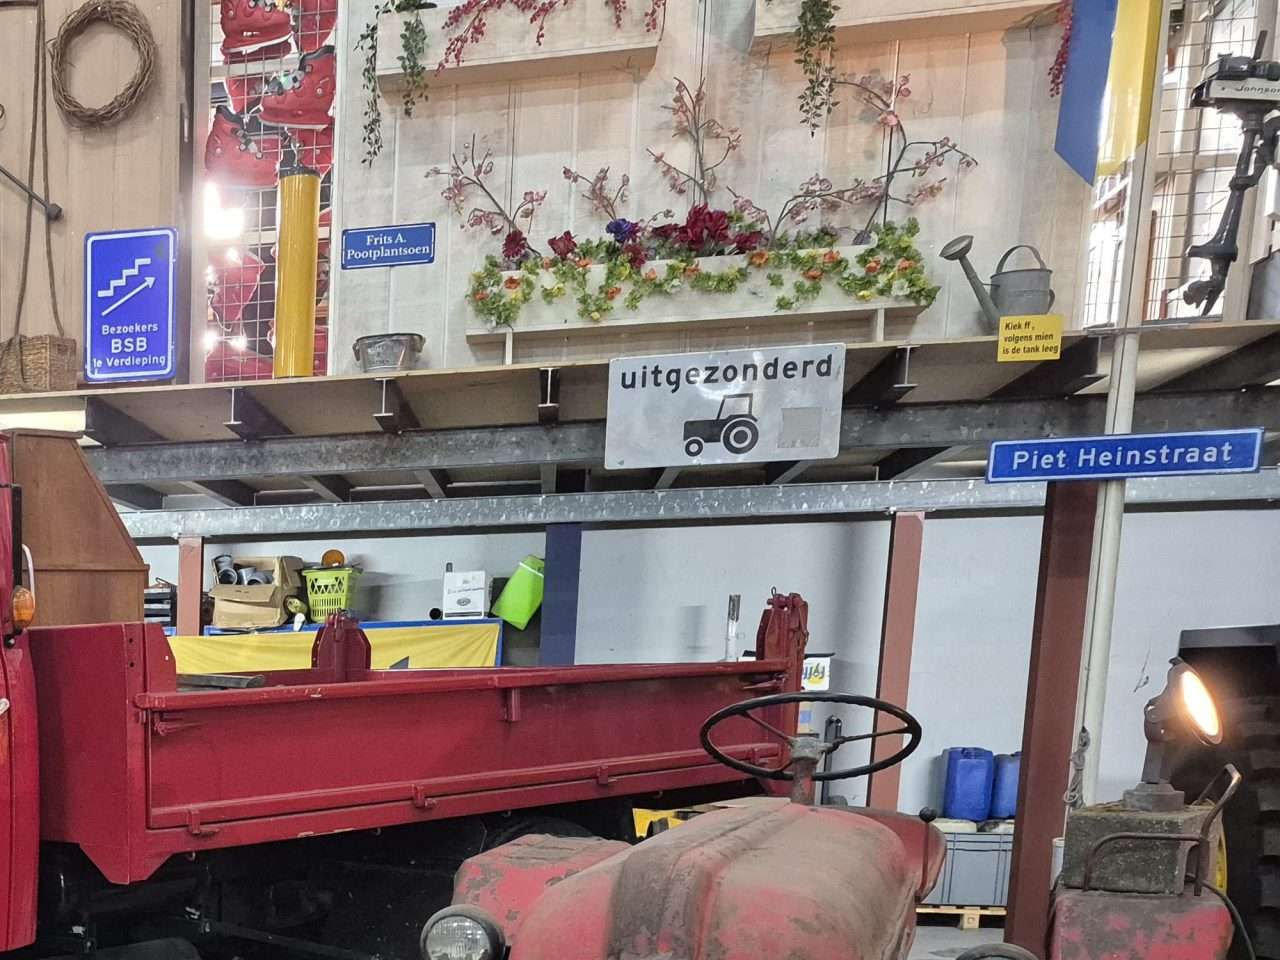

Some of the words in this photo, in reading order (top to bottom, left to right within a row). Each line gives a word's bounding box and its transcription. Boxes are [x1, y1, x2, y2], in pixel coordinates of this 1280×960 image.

[366, 234, 393, 246] Frits
[395, 233, 407, 244] A.
[347, 246, 430, 260] Pootplantsoen
[101, 323, 158, 335] Bezoekers
[1005, 322, 1022, 330] Kiek
[1004, 334, 1033, 343] volgens
[1035, 332, 1054, 341] mien
[111, 337, 148, 353] BSB
[1023, 345, 1040, 353] tank
[1041, 344, 1059, 353] leeg
[106, 355, 166, 367] Verdieping
[621, 354, 833, 394] uitgezonderd
[1012, 450, 1067, 470] Piet
[1077, 441, 1233, 468] Heinstraat
